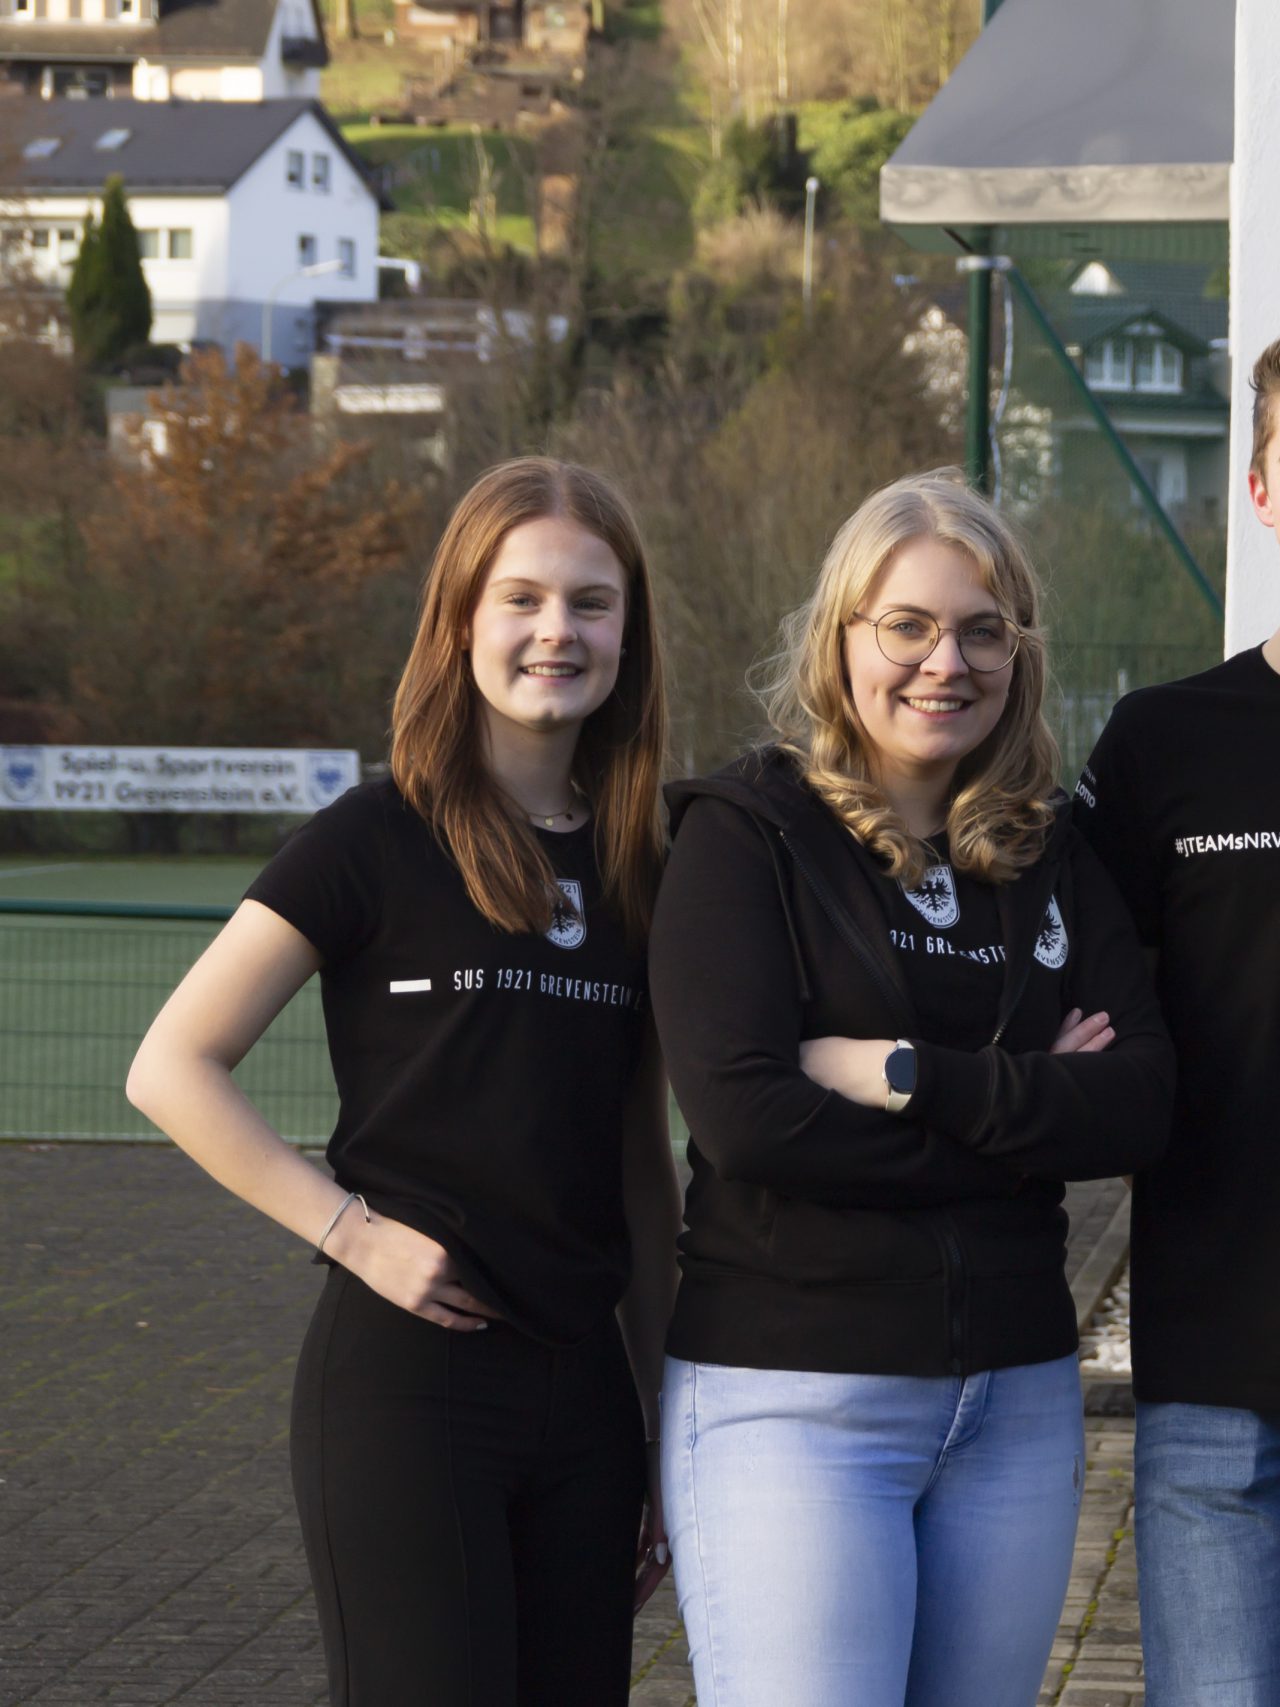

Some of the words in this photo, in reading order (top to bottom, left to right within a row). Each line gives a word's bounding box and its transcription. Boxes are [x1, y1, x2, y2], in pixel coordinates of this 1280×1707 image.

[154, 752, 296, 778] Sportverein
[54, 780, 106, 801] 1921
[114, 781, 256, 805] Grevenstein
[1075, 780, 1096, 809] LOTTO
[453, 968, 485, 991] SUS
[496, 969, 533, 990] 1921
